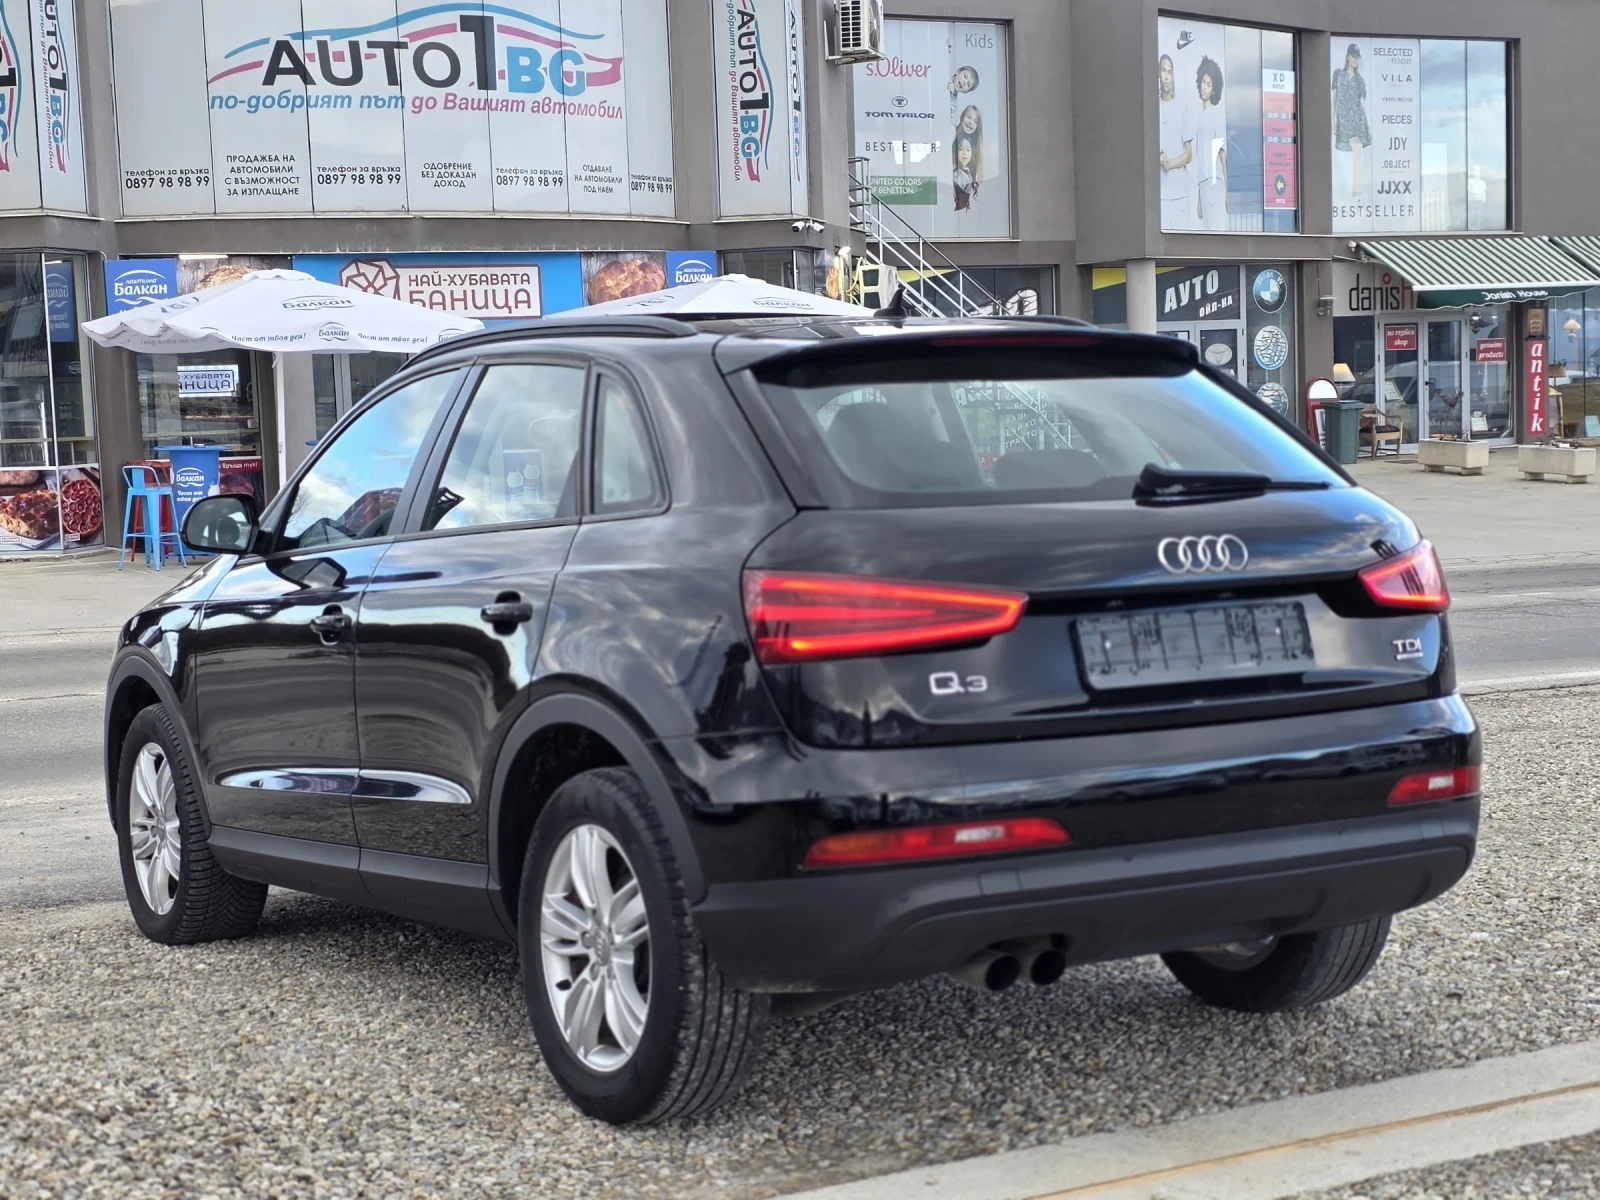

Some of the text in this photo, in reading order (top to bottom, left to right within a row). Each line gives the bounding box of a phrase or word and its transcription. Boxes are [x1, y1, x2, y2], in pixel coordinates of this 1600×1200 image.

[965, 33, 994, 49] Kids
[1373, 47, 1413, 57] SELECTED
[866, 56, 932, 79] s.Oliver
[729, 70, 738, 85] до
[1381, 74, 1413, 82] VILA
[210, 89, 623, 119] по-добрият път до Вашият автомобил
[731, 85, 740, 125] Вашият
[1382, 114, 1413, 125] PIECES
[1389, 137, 1408, 151] JDY
[226, 154, 296, 163] ПРОДАЖБА НА
[732, 127, 743, 181] автомобил
[230, 165, 294, 174] АВТОМОБИЛИ
[317, 165, 357, 174] телефон
[372, 166, 402, 174] връзка
[423, 162, 472, 171] ОДОБРЕНИЕ
[582, 164, 614, 173] ОТДАВАНЕ
[125, 169, 165, 177] телефон
[180, 168, 210, 176] връзка
[421, 171, 477, 180] БЕЗ ДОКАЗАН
[495, 167, 529, 176] телефон
[539, 169, 564, 177] връзка
[126, 176, 210, 189] 0897 98 98 99
[224, 176, 300, 185] С ВЪЗМОЖНОСТ
[317, 174, 402, 185] 0897 98 98 99
[433, 179, 467, 188] ДОХОД
[496, 175, 564, 188] 0897 98 98 99
[585, 175, 623, 185] АВТОМОБИЛИ
[894, 178, 922, 186] COLORS
[227, 187, 299, 196] ЗА ИЗПЛАЩАНЕ
[583, 185, 615, 194] ПОД НАЕМ
[630, 181, 646, 192] 0897
[1377, 181, 1412, 195] JJXX
[1332, 205, 1415, 218] BESTSELLER
[408, 270, 532, 287] НАЙ-ХУБАВАТА
[114, 283, 169, 296] Балкан
[1481, 291, 1516, 301] Danish
[282, 299, 353, 309] Балкан
[409, 288, 532, 315] БАНИЦА
[318, 329, 350, 337] Балкан
[1394, 339, 1409, 347] shop
[1479, 351, 1504, 360] products
[1530, 342, 1544, 432] antik
[1392, 638, 1422, 653] TDI
[929, 671, 989, 695] Q3
